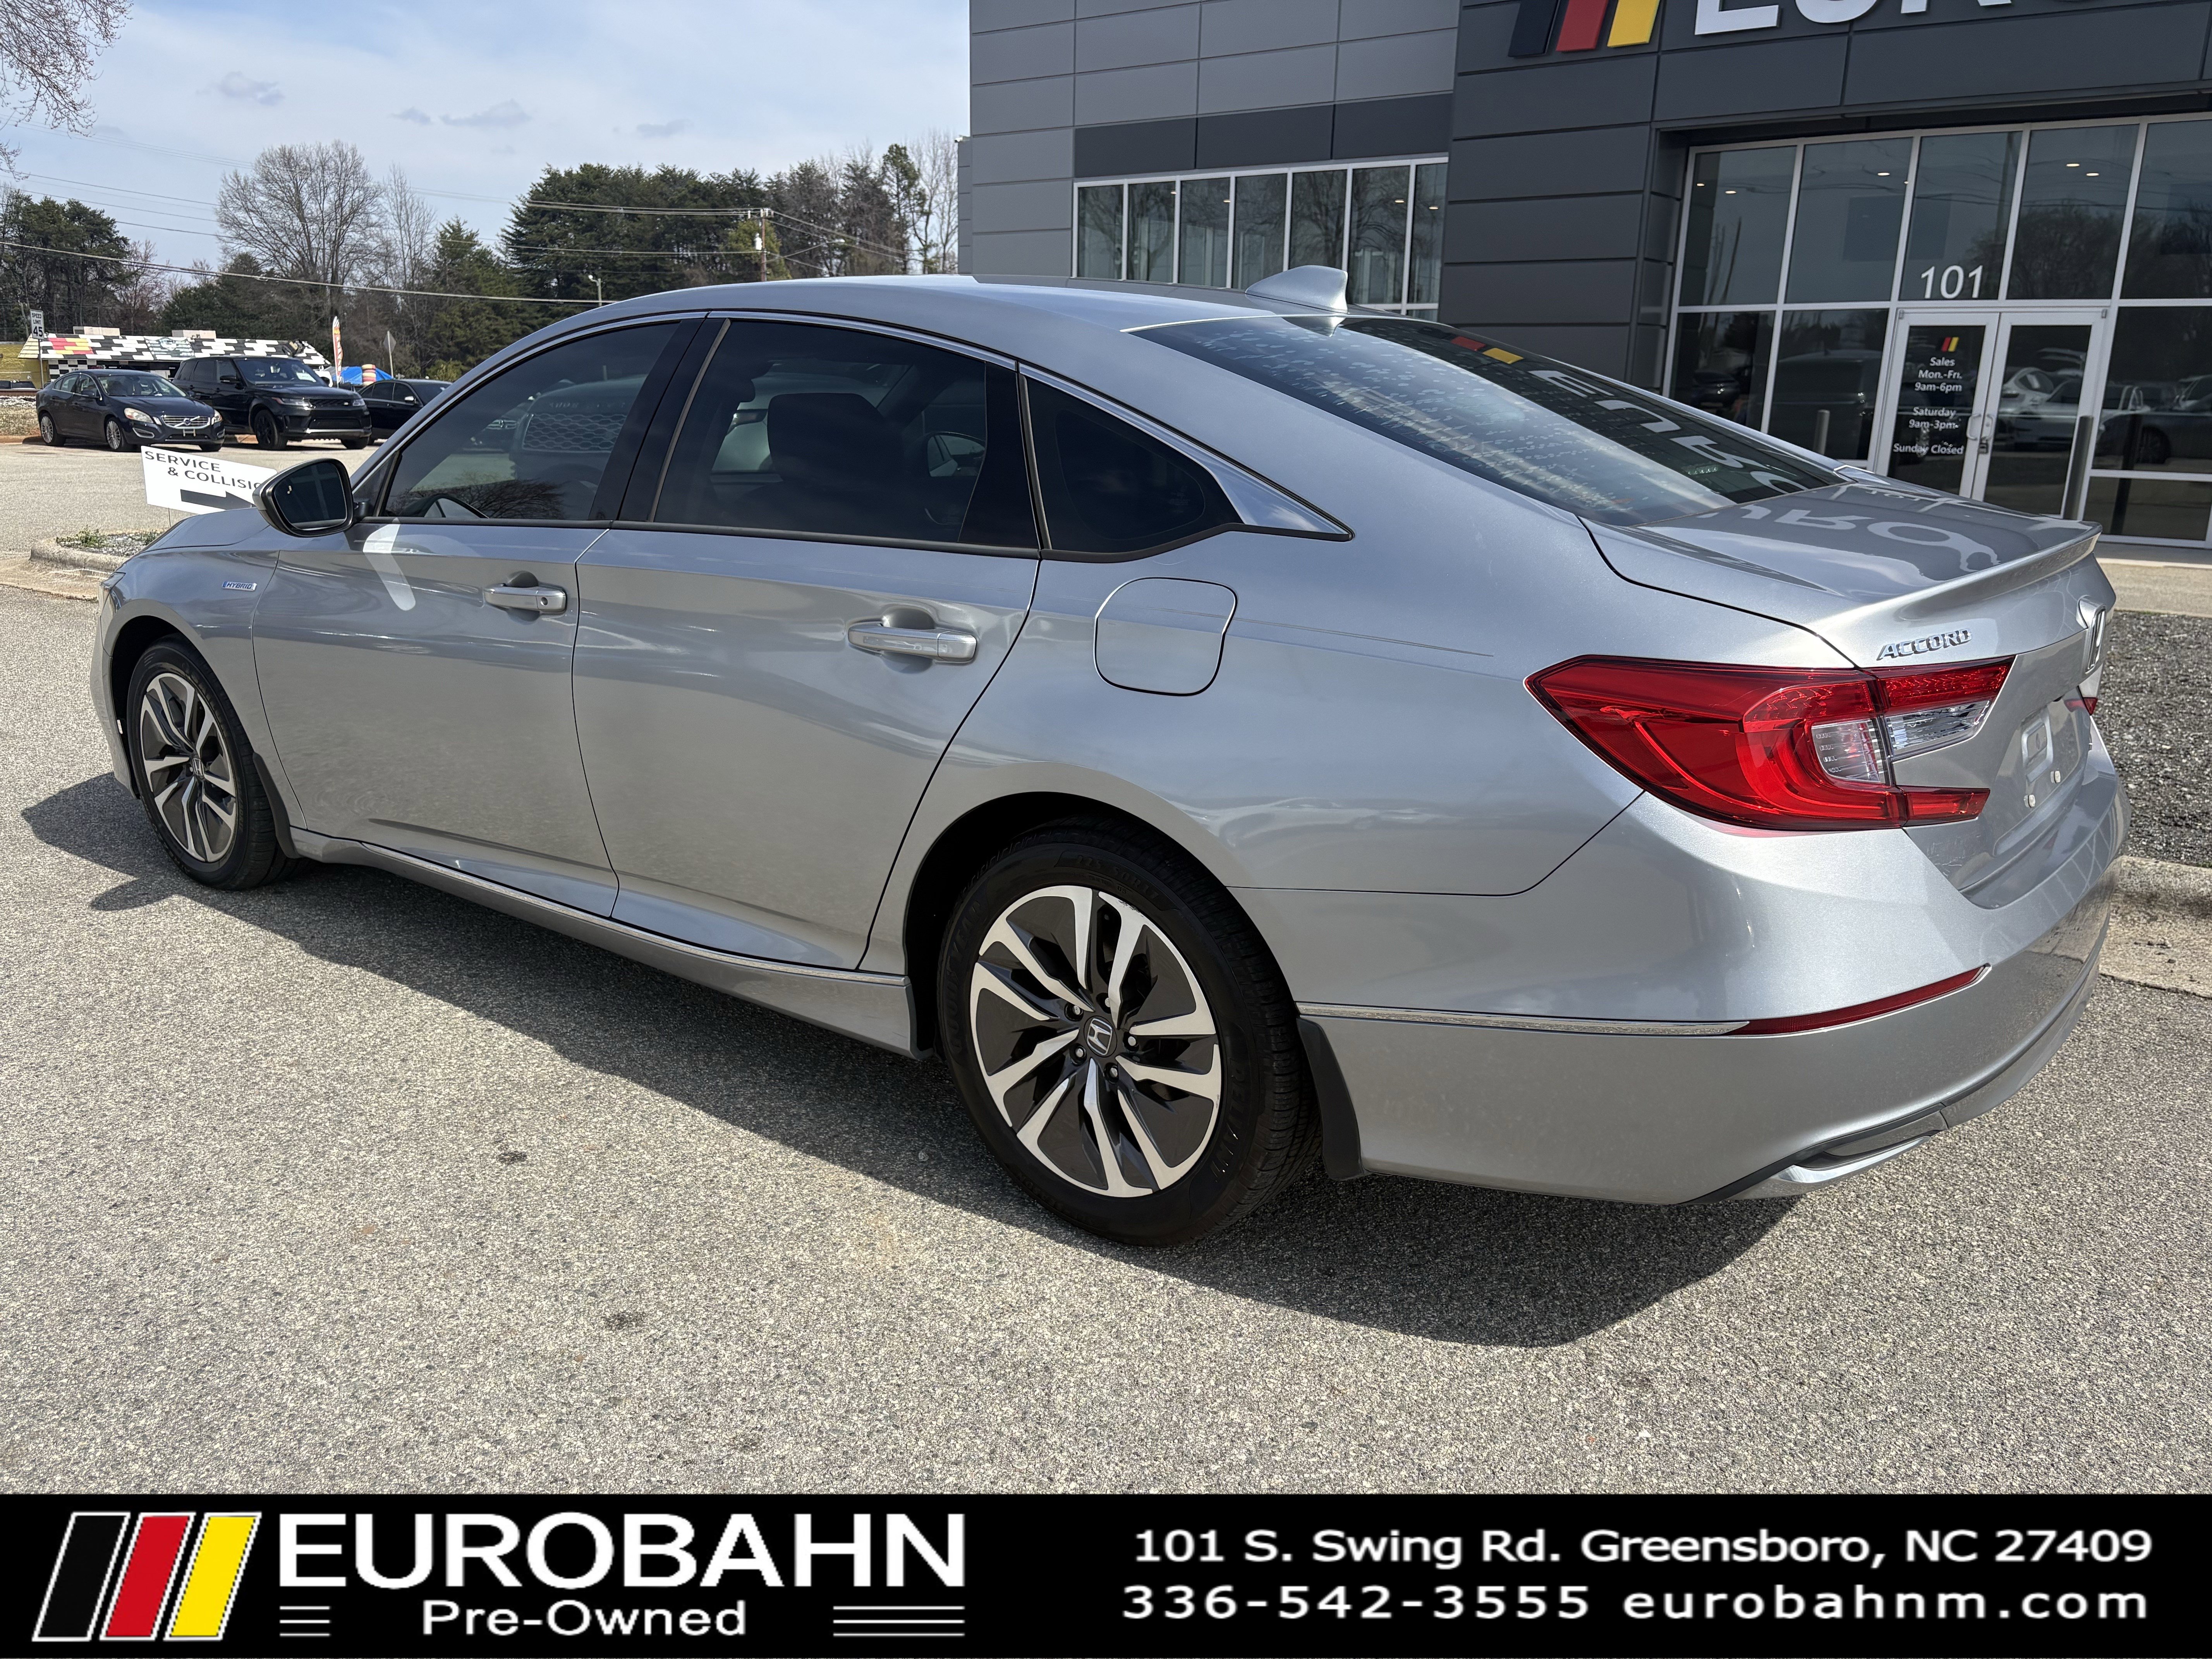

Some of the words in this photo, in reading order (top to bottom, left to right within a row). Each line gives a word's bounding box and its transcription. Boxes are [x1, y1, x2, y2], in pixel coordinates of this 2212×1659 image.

[1921, 265, 1983, 299] 101
[33, 326, 43, 337] 45
[1930, 357, 1955, 366] Sales
[1915, 382, 1963, 394] 9am-6pm
[1913, 407, 1956, 419] Saturday
[1908, 419, 1956, 431] 9am-3pm
[1893, 443, 1929, 457] Sunday
[1931, 445, 1964, 455] Closed
[145, 451, 221, 472] SERVICE
[168, 467, 179, 476] &
[1876, 628, 1973, 661] ACCORD
